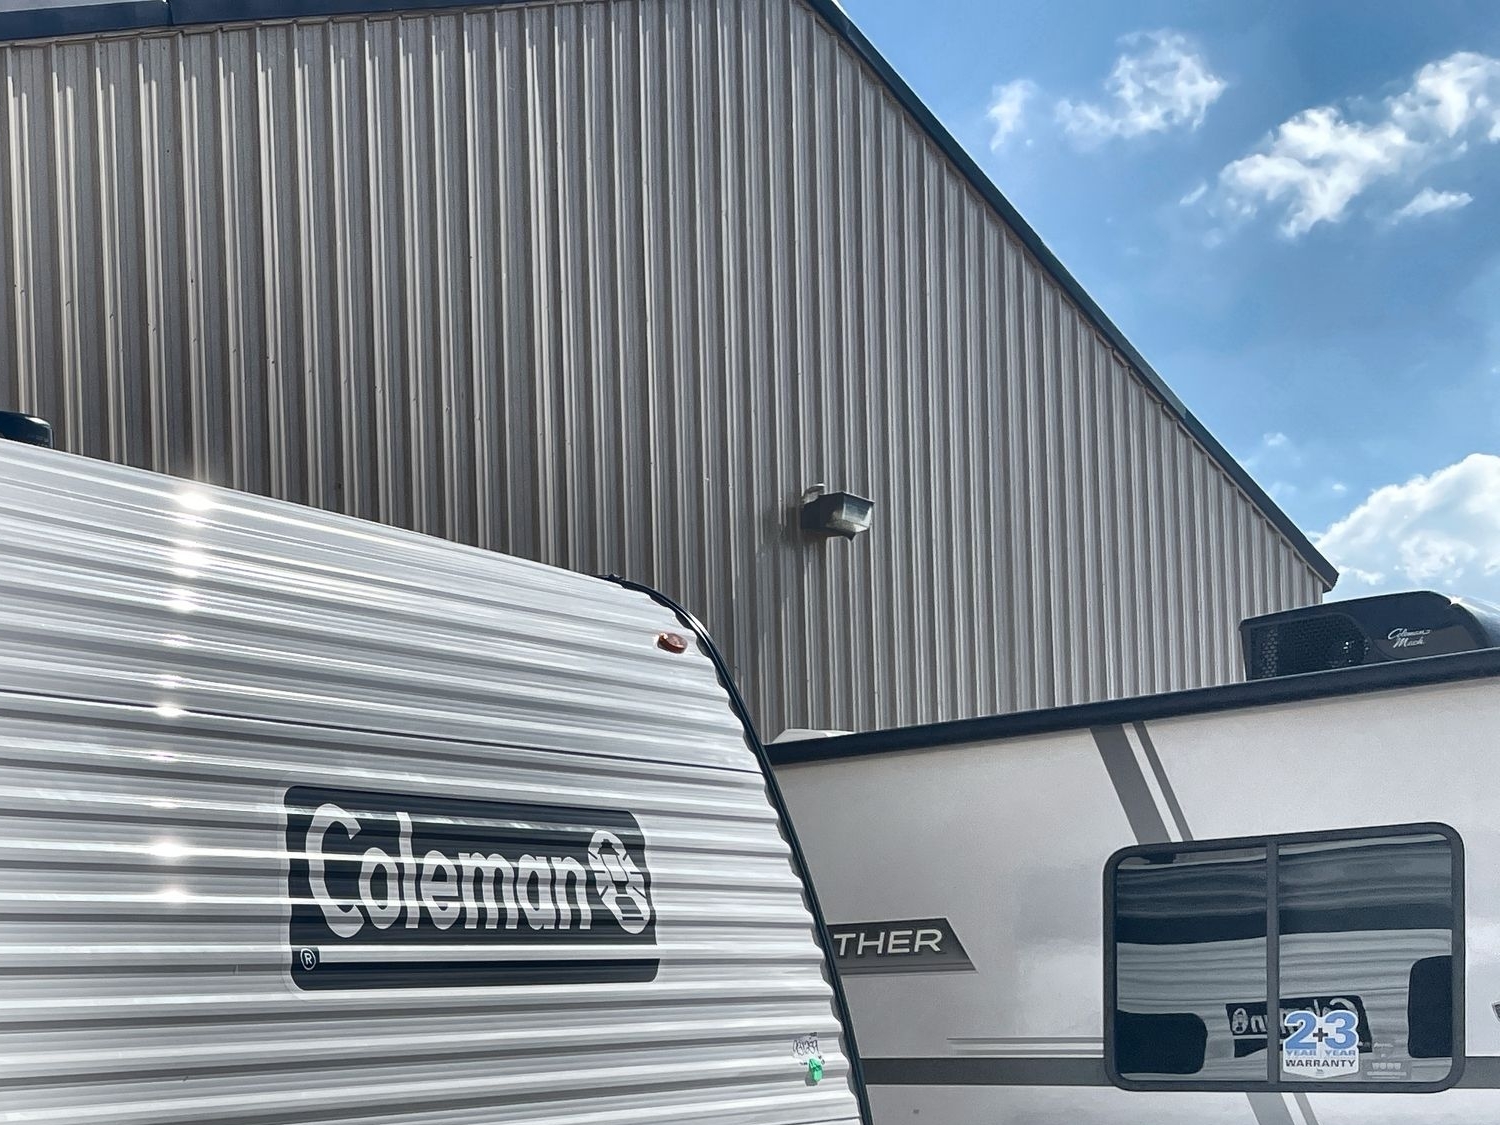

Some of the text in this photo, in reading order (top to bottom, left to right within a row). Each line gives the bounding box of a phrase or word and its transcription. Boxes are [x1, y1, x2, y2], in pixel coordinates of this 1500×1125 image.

[305, 803, 592, 938] Coleman
[833, 928, 943, 956] THER
[1285, 1059, 1356, 1068] WARRANTY
